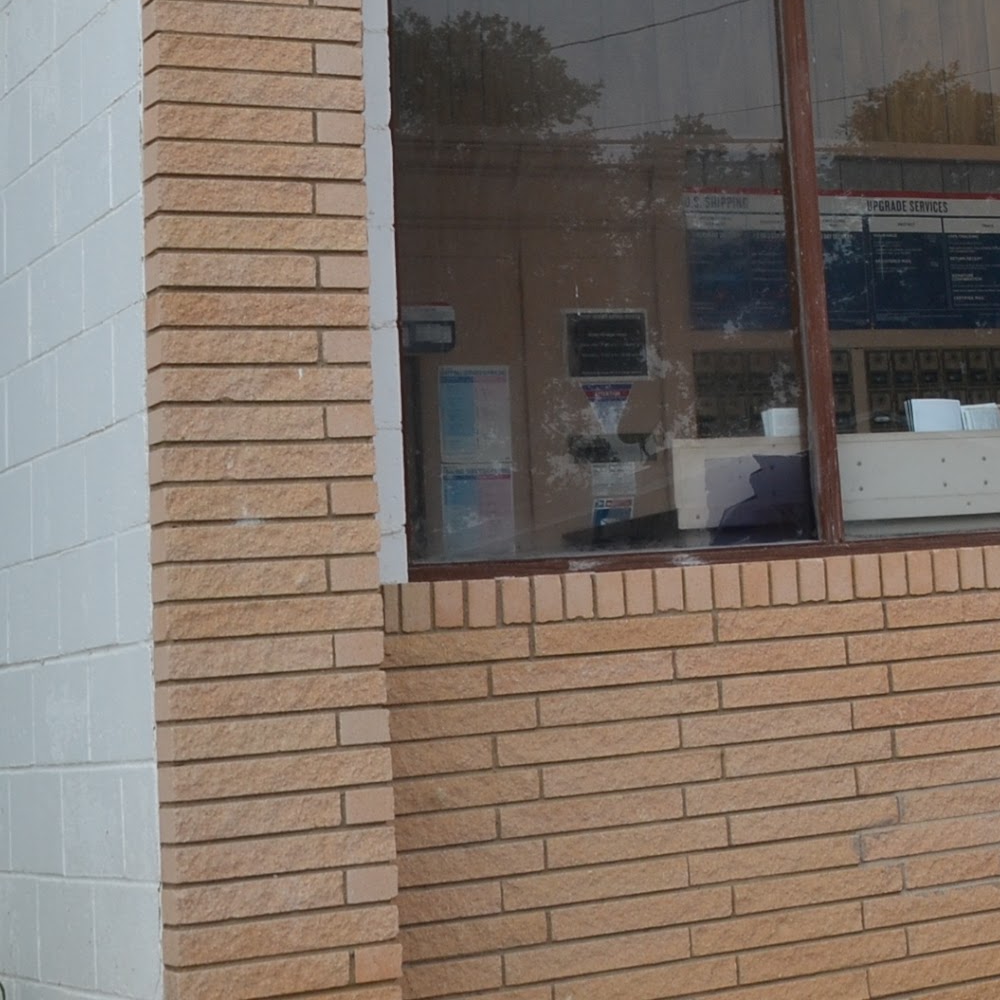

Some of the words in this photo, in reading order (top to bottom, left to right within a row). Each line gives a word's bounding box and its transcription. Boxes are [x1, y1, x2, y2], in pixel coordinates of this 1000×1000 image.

[703, 196, 749, 209] SHIPPING
[866, 199, 907, 212] UPGRADE
[909, 200, 949, 214] SERVICES
